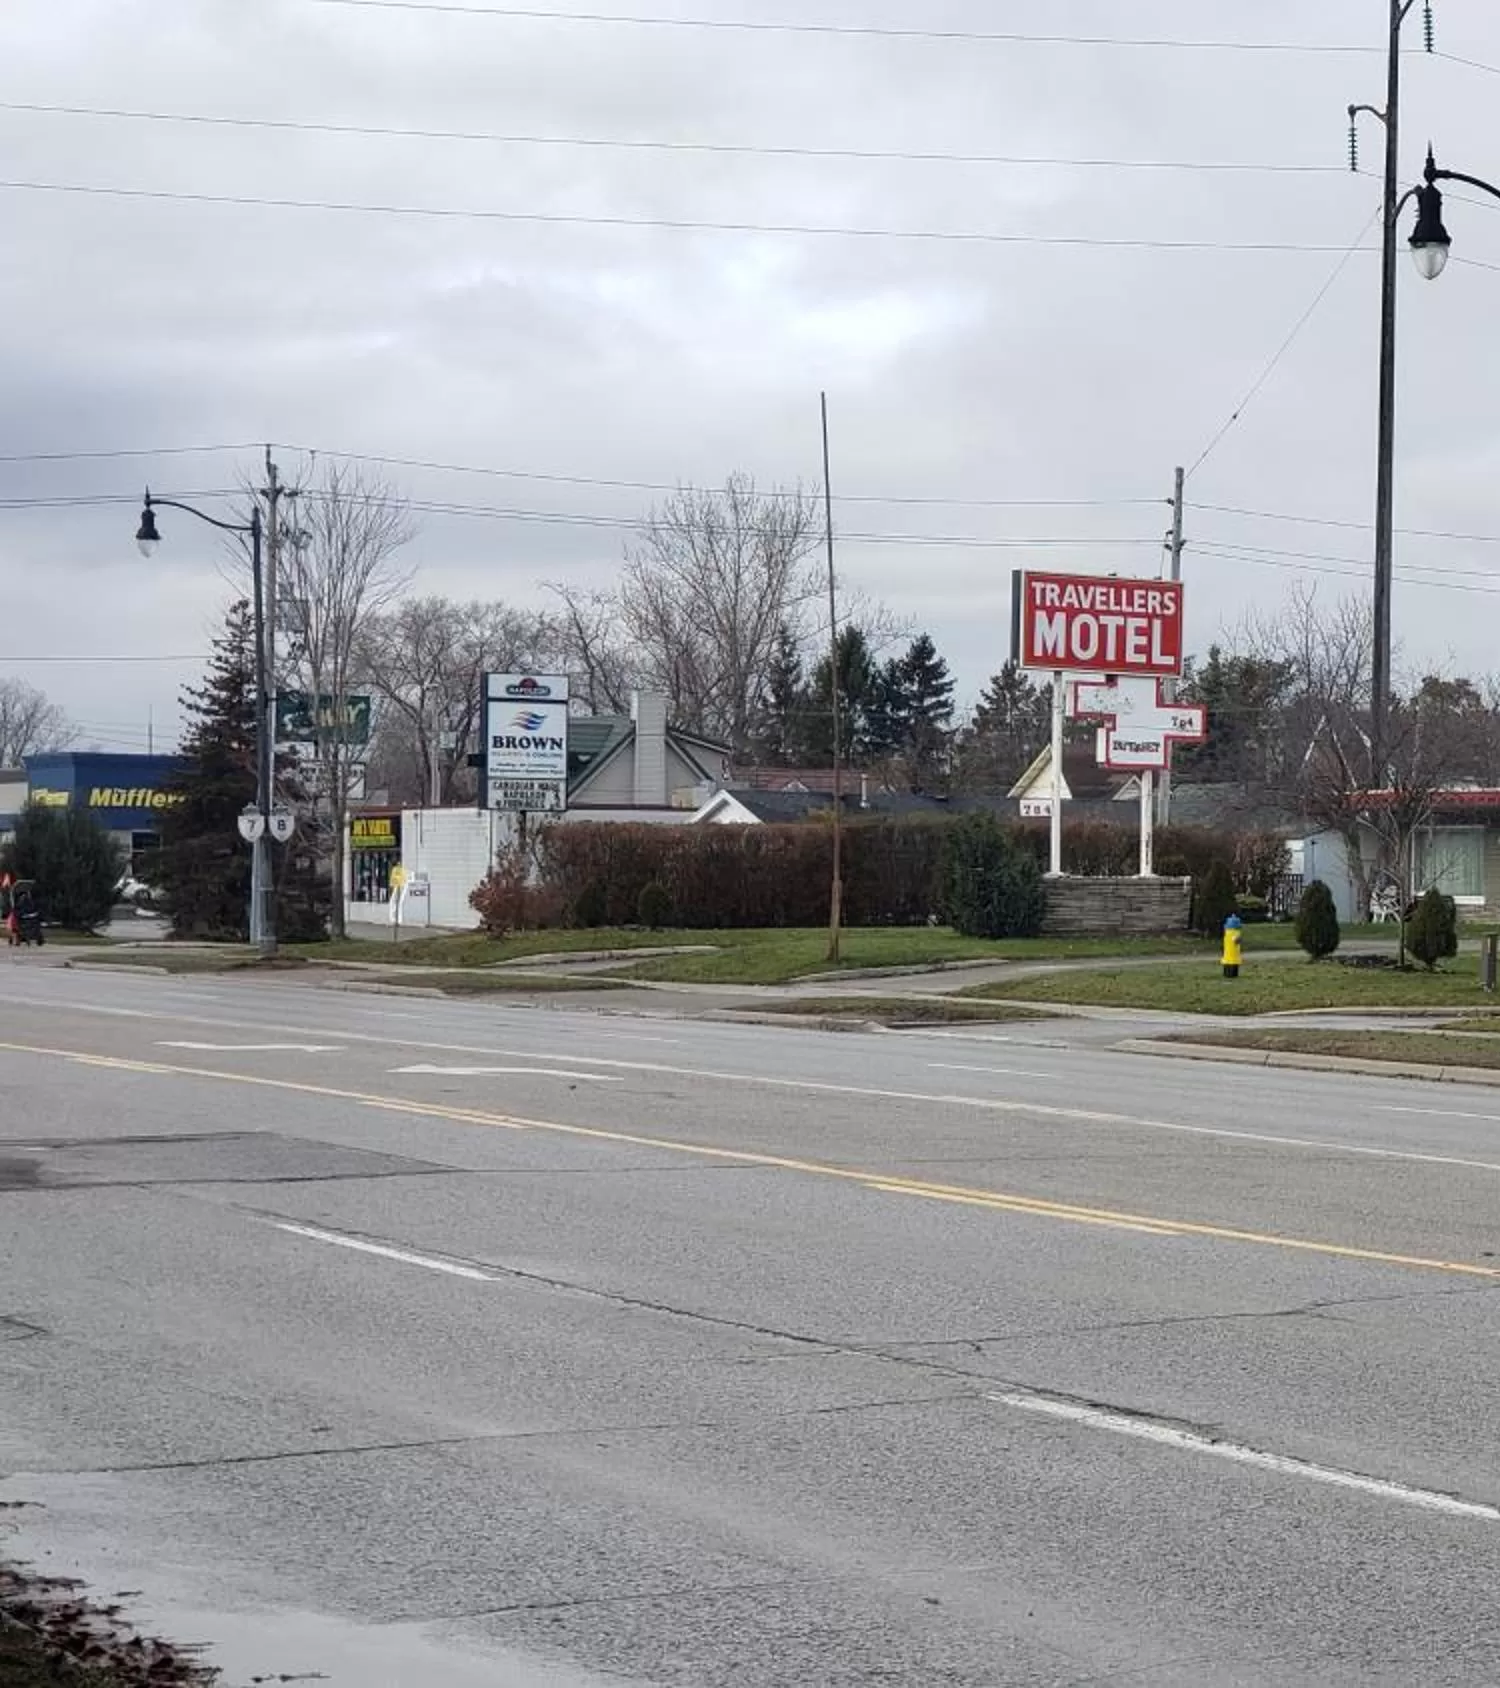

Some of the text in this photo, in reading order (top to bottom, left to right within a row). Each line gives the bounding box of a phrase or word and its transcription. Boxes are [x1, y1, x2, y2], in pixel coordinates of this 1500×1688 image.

[1032, 582, 1176, 615] TRAVELLERS
[1034, 610, 1174, 665] MOTEL
[492, 736, 563, 750] BROWN
